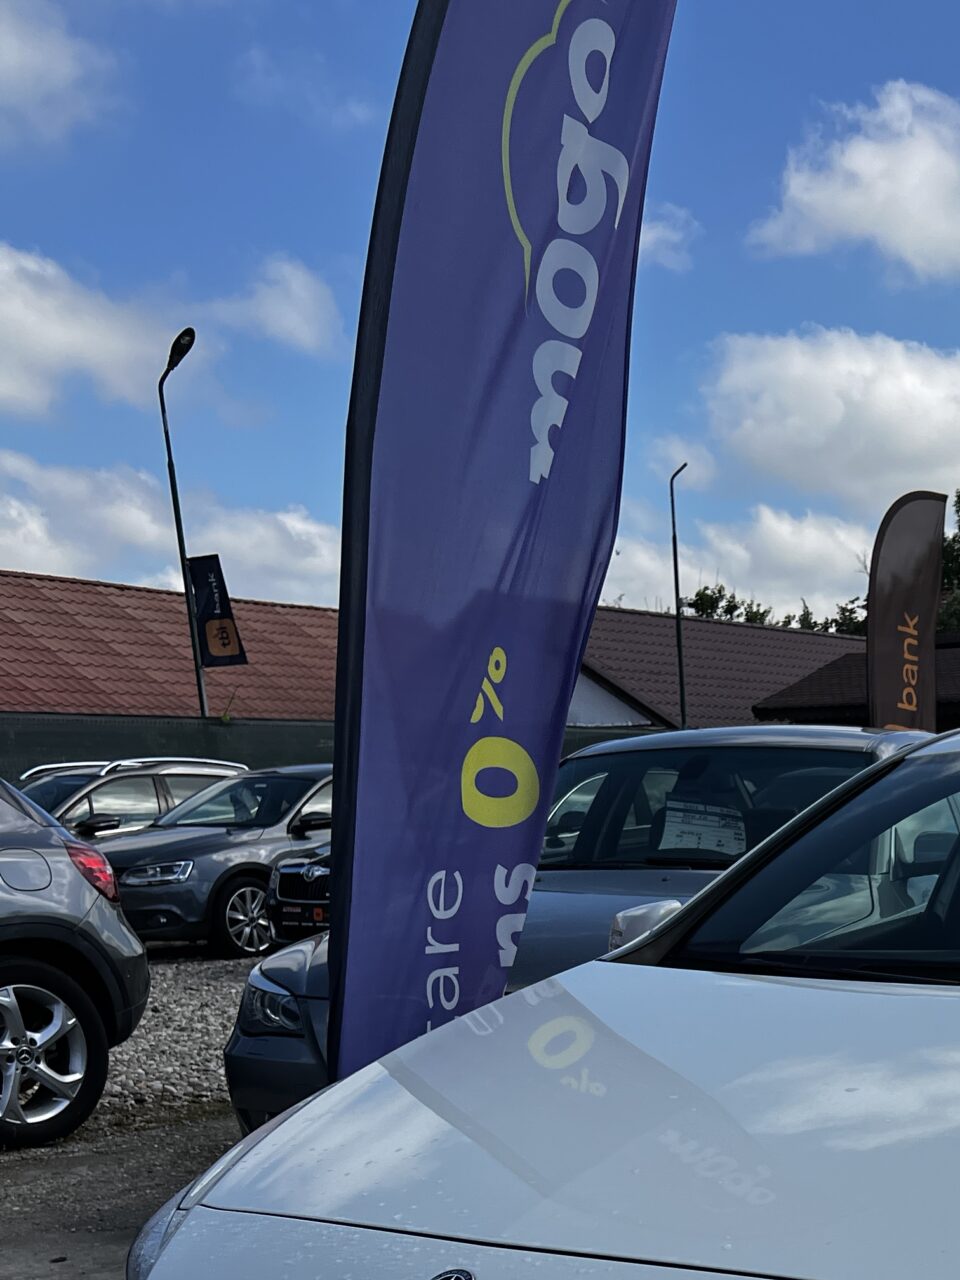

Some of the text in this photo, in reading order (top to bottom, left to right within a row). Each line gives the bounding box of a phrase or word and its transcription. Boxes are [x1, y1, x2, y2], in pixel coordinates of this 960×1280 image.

[529, 17, 630, 485] mogo
[897, 611, 920, 712] bank
[425, 868, 463, 1033] are
[460, 646, 540, 997] ns 0%
